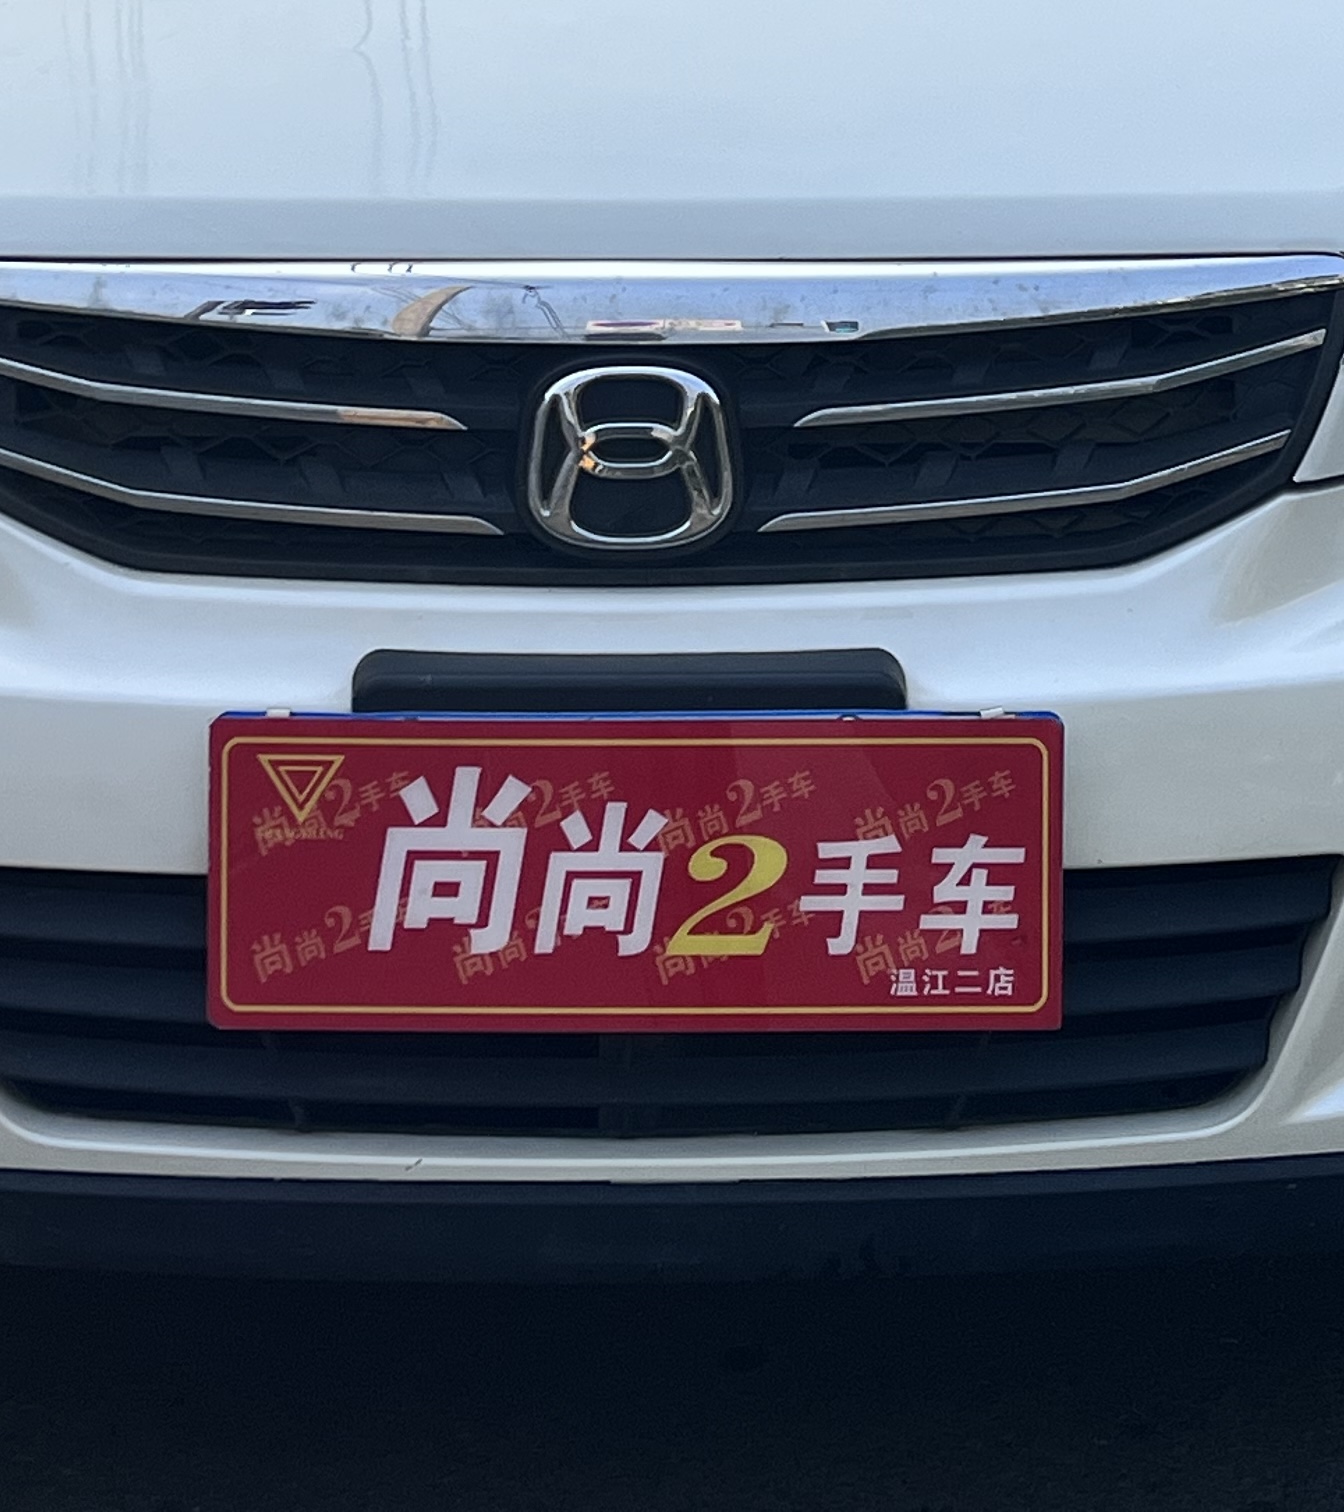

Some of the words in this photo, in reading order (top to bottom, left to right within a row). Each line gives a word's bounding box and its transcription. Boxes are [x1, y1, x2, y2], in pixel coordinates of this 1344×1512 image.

[367, 766, 1026, 956] 尚尚2手车
[889, 965, 1016, 997] 温江二店
